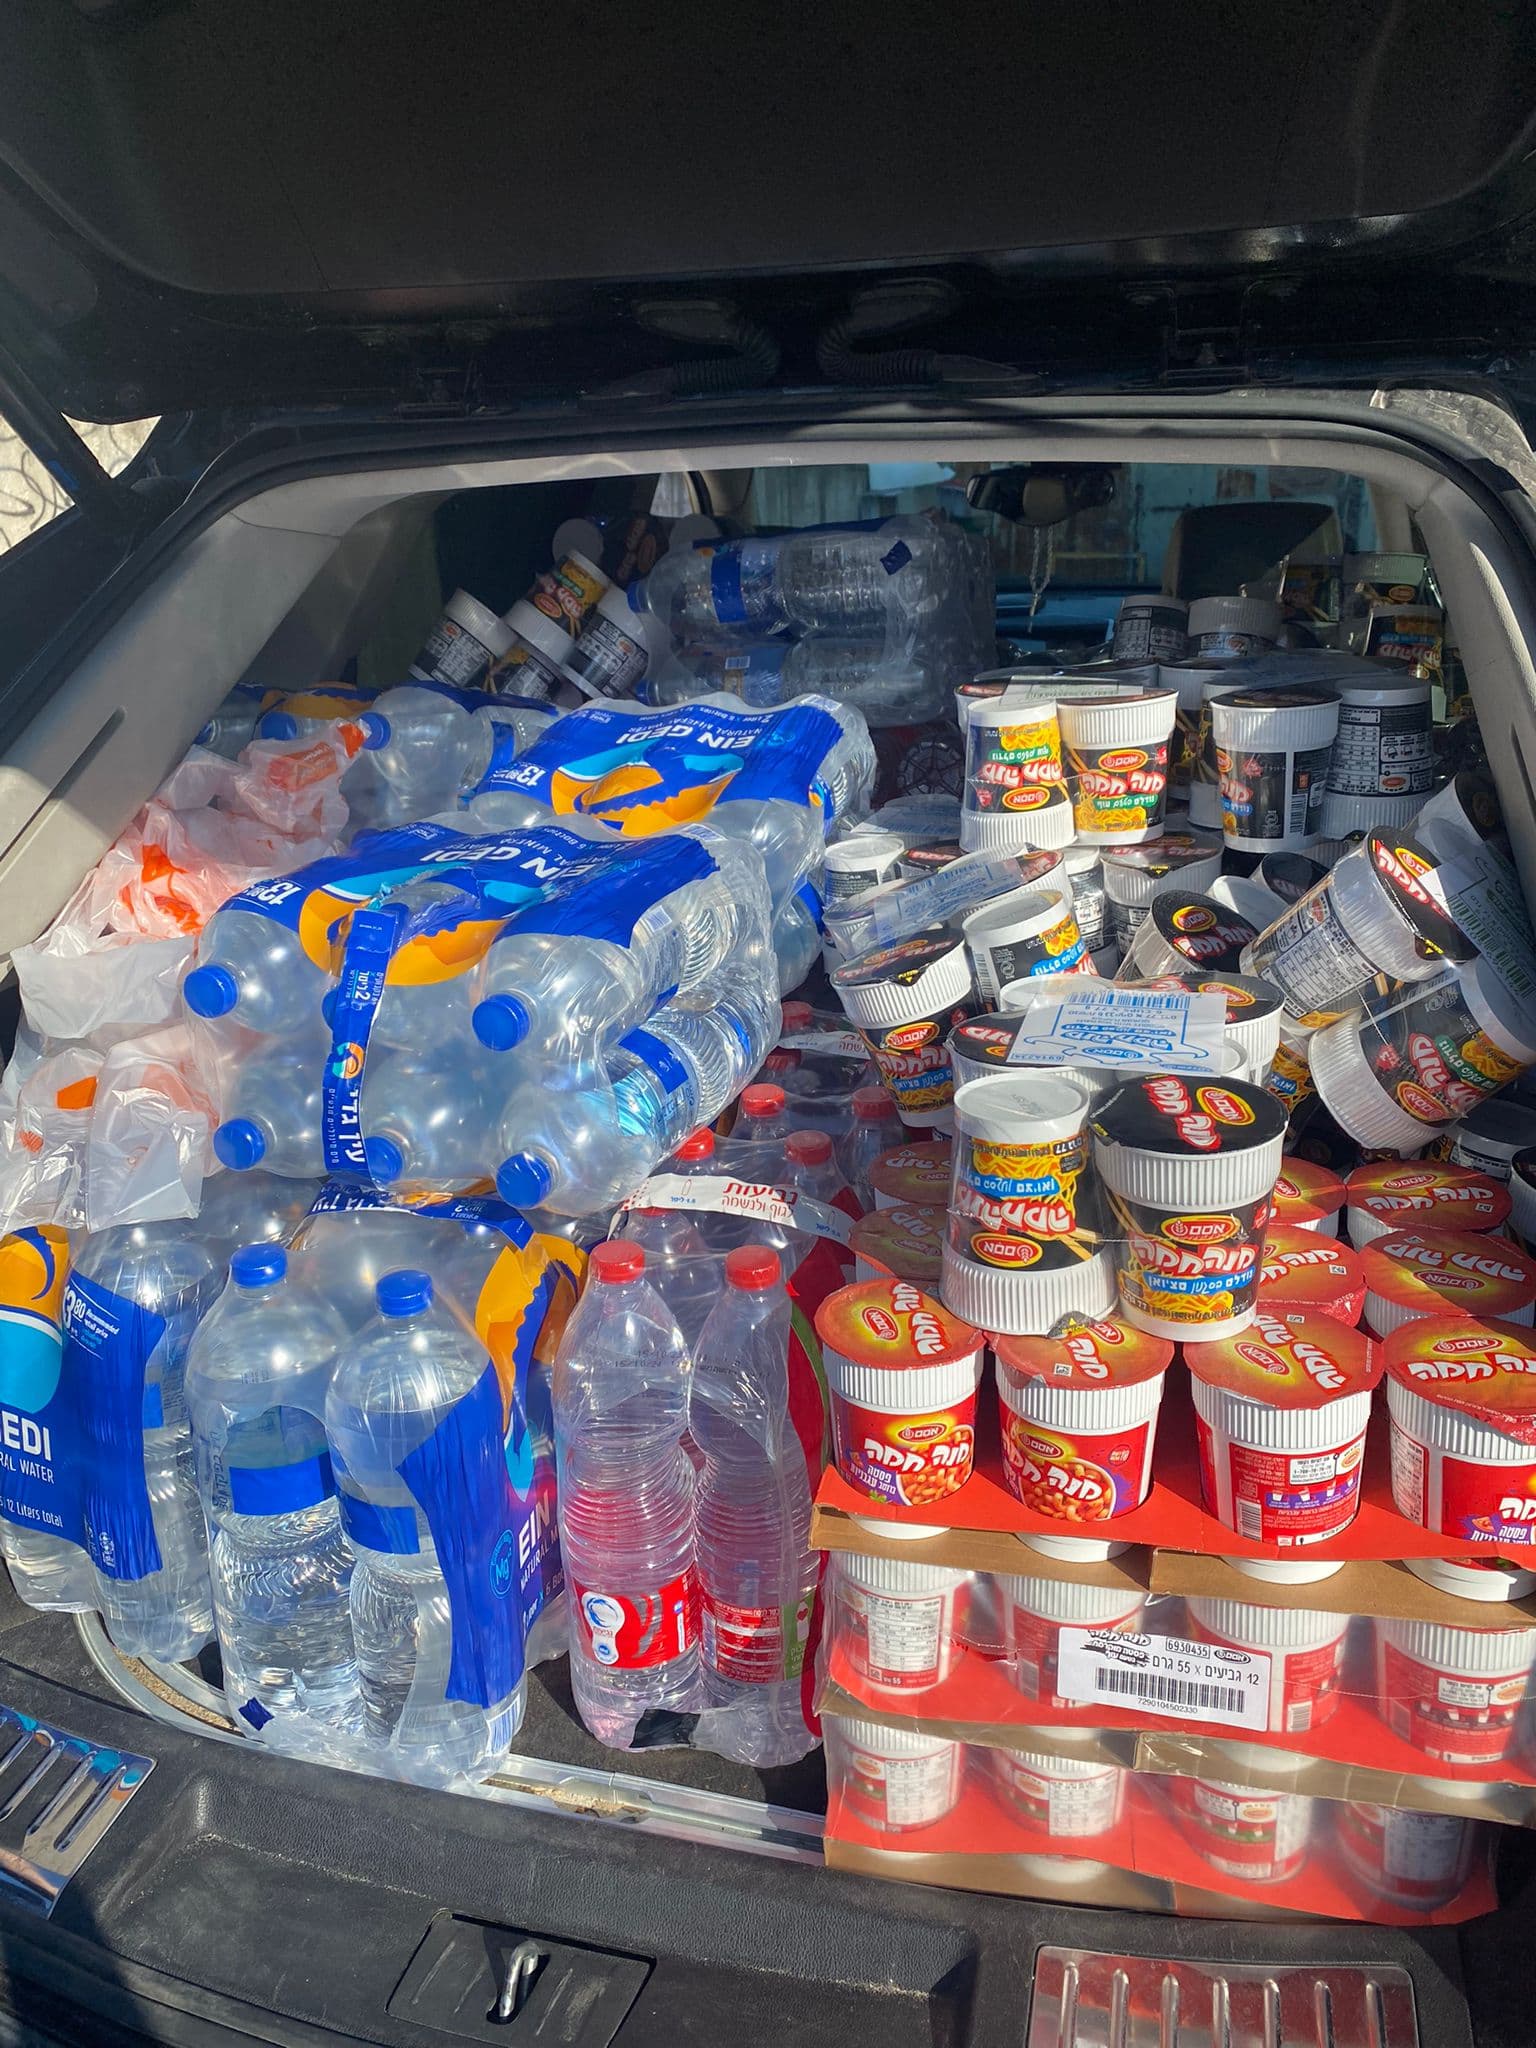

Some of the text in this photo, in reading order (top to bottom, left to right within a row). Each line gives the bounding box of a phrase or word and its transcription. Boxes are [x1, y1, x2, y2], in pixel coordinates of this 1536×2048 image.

[616, 724, 755, 749] EIN GEDI
[1022, 760, 1062, 781] חמה
[1081, 770, 1165, 796] מנה חמה
[419, 845, 597, 881] EIN GEDI
[1376, 845, 1430, 905] חמה
[354, 970, 371, 1001] 2 ליטר
[902, 1029, 929, 1044] אסם
[341, 1088, 360, 1125] גדי
[1148, 1079, 1189, 1114] חמה
[1178, 1114, 1218, 1147] מנה
[338, 1133, 366, 1163] עין
[1055, 1143, 1067, 1154] 77
[1399, 1175, 1427, 1187] אסם
[720, 1194, 767, 1212] ולנשמה
[723, 1182, 799, 1207] נביעות
[1364, 1186, 1494, 1211] מנה חמה
[1000, 1201, 1071, 1233] חמה
[1188, 1223, 1226, 1237] אסם
[983, 1241, 1017, 1257] אסם
[1133, 1235, 1256, 1275] מנה חמה
[1279, 1249, 1340, 1265] מנה
[1383, 1243, 1527, 1283] מנה חמה
[1425, 1272, 1465, 1288] אסם
[893, 1282, 946, 1356] מנה חמה
[1251, 1314, 1295, 1346] מנה
[1292, 1342, 1347, 1391] חמה
[1455, 1339, 1490, 1350] אסם
[1067, 1337, 1110, 1380] מנה
[1407, 1353, 1536, 1381] נה חמה
[0, 1410, 52, 1462] EDI
[914, 1426, 939, 1439] אסם
[864, 1437, 970, 1473] מנה חמה
[1030, 1441, 1055, 1454] אסם
[19, 1459, 55, 1485] WATER
[867, 1464, 893, 1484] פסטה
[1047, 1465, 1104, 1501] מנה
[6, 1498, 64, 1529] 12 Liters total
[1498, 1497, 1536, 1521] מה
[518, 1488, 550, 1570] EIN
[1498, 1525, 1529, 1541] פסטה
[520, 1537, 550, 1595] NATURAL
[1122, 1630, 1152, 1647] מנה
[1167, 1638, 1210, 1658] 6930435
[1151, 1655, 1175, 1671] גרם
[1176, 1660, 1192, 1675] 55
[1204, 1665, 1243, 1684] גביעים
[1246, 1672, 1261, 1687] 12
[1137, 1697, 1199, 1715] 7290104502330
